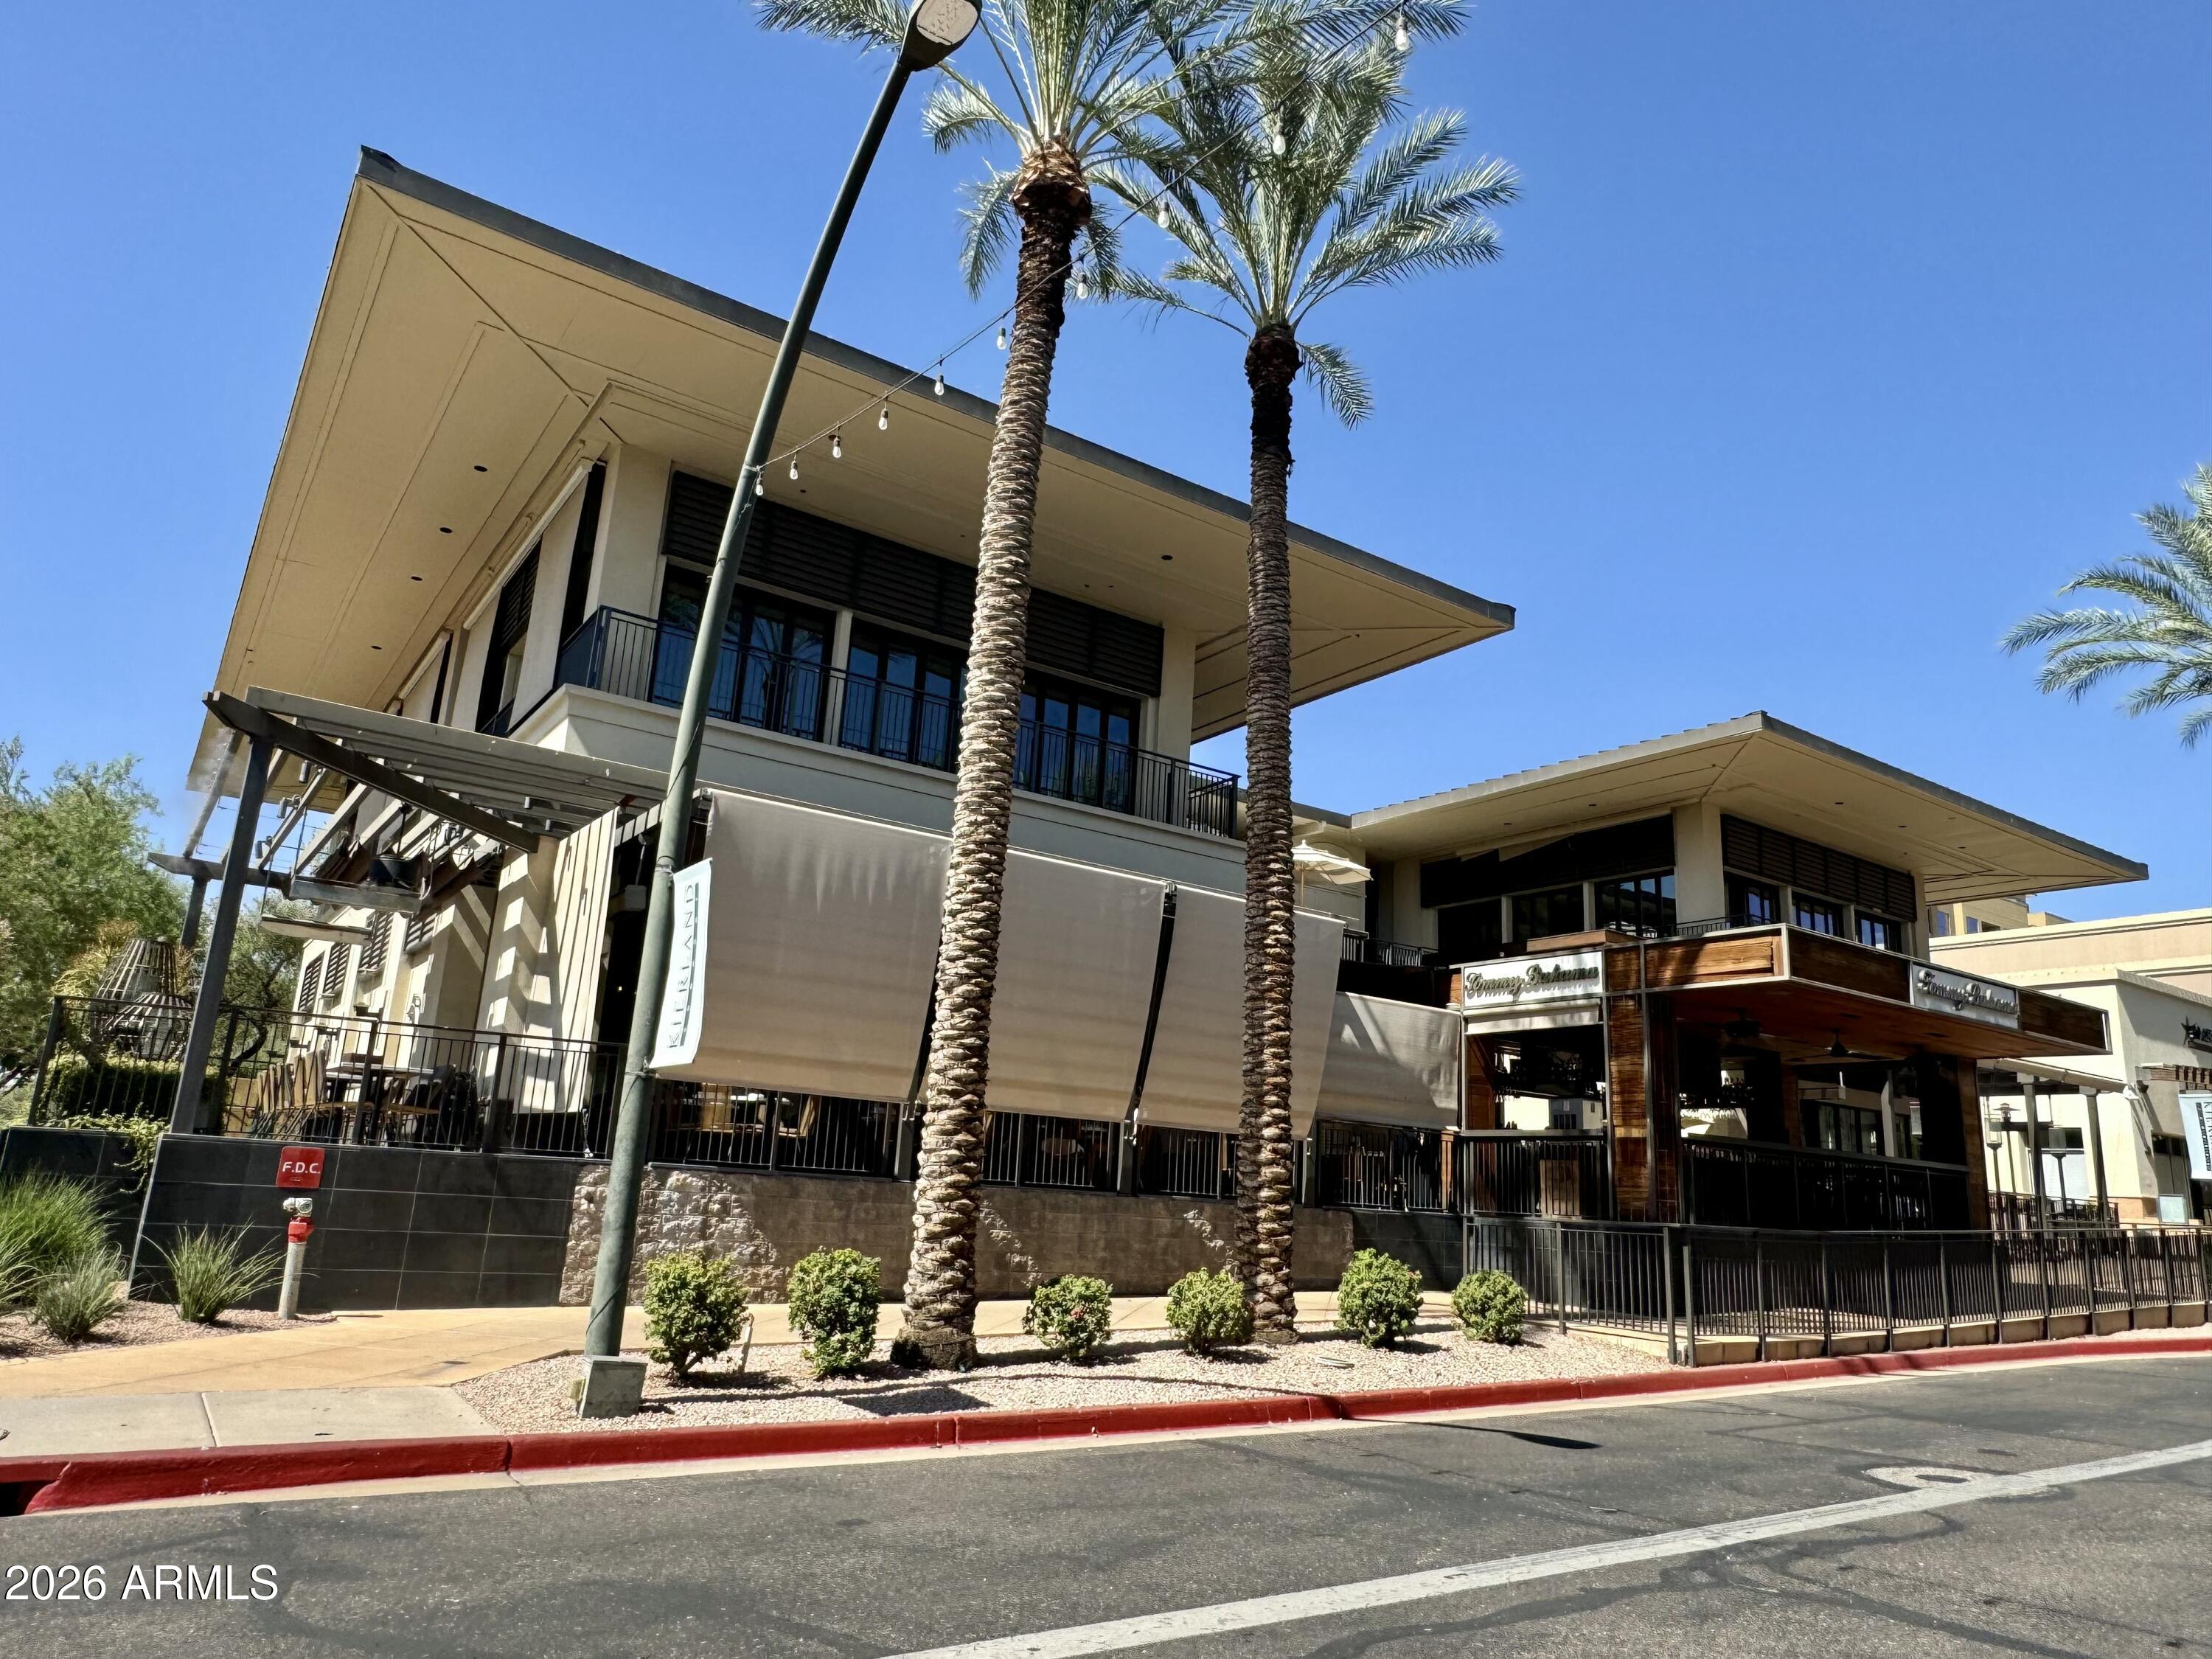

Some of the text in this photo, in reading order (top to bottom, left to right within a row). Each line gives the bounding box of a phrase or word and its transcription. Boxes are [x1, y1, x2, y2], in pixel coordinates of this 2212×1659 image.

[1464, 964, 1599, 996] Tommy Bahama
[282, 1161, 321, 1174] F.D.C.
